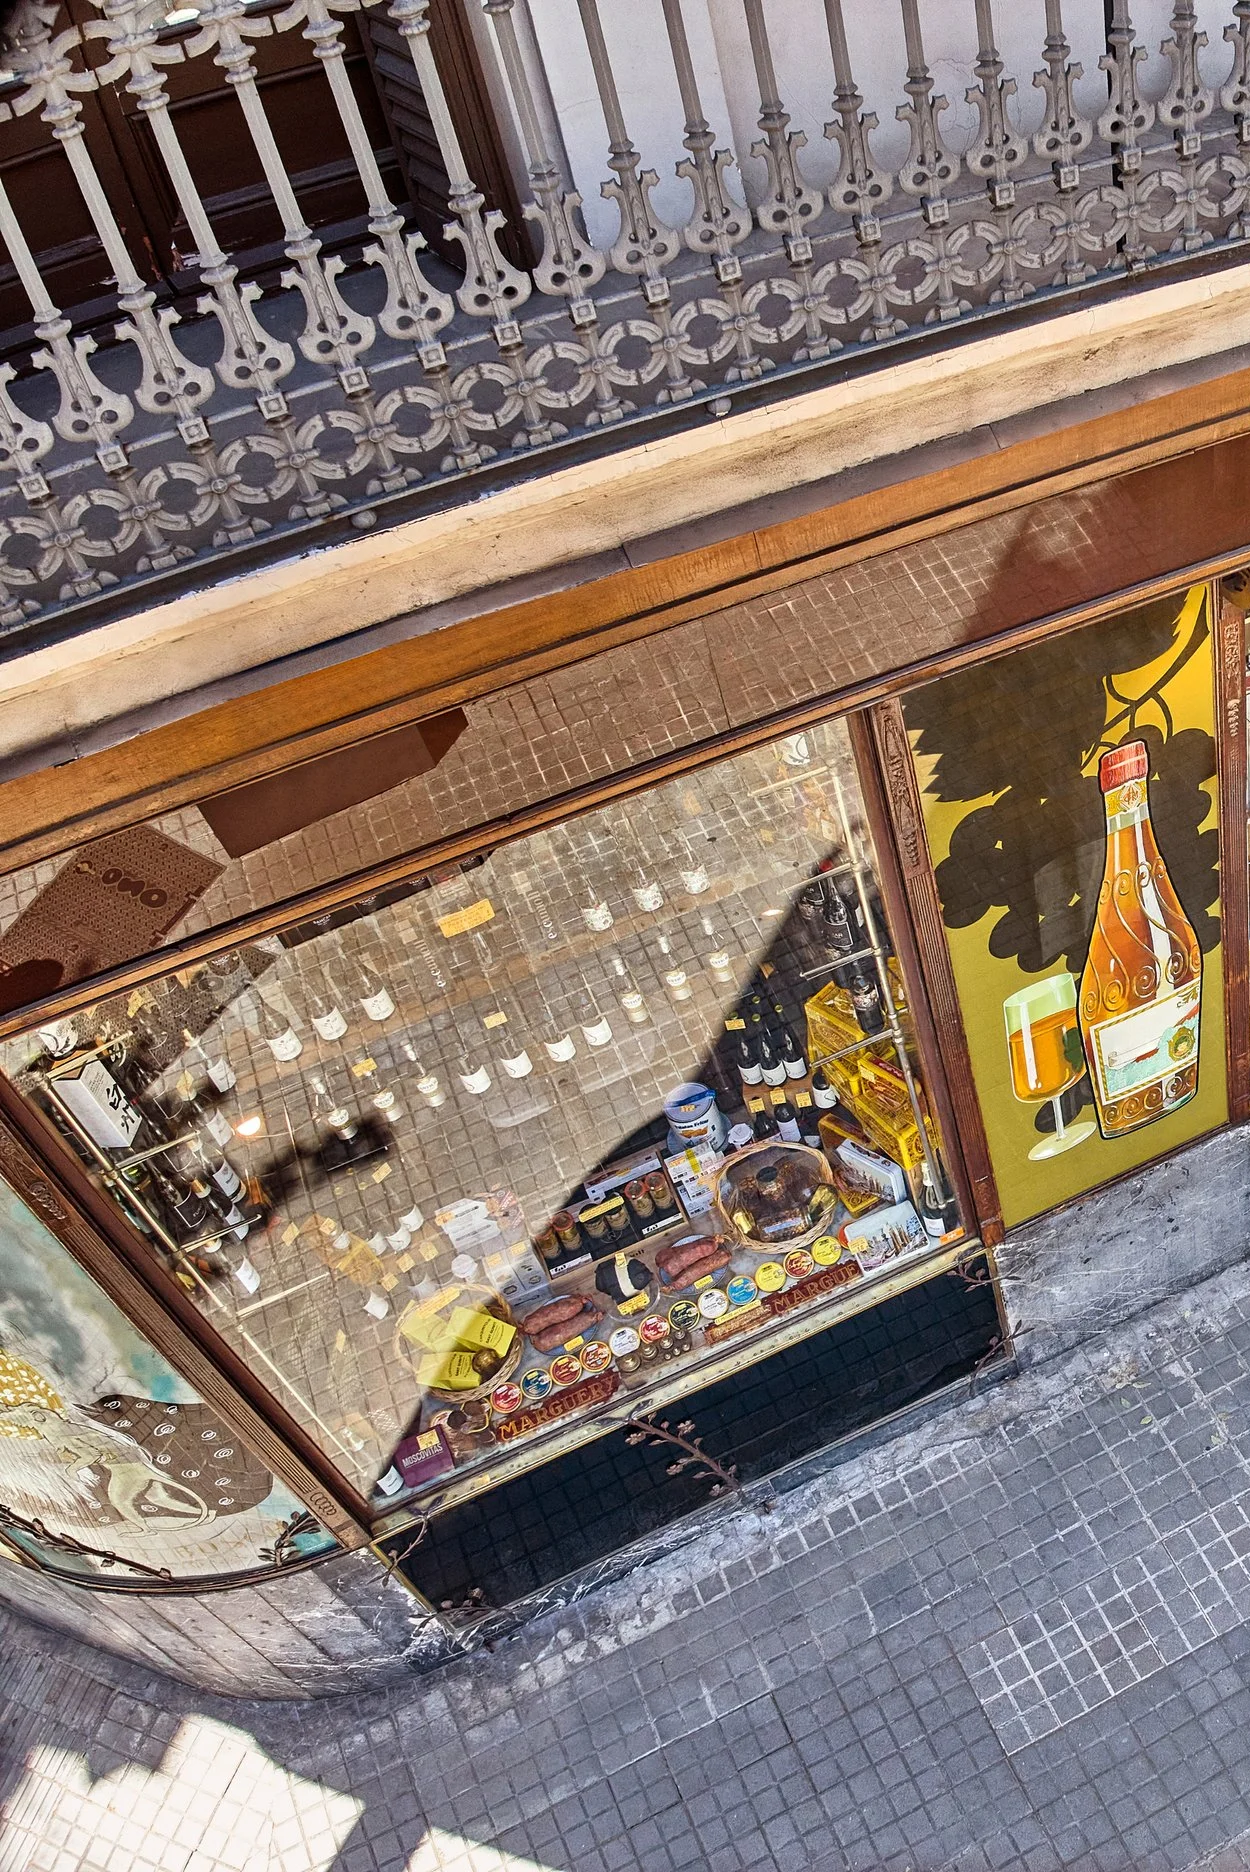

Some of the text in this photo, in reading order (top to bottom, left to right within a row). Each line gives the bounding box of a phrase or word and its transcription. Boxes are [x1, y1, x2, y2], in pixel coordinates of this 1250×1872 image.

[773, 1262, 860, 1315] MARGUE
[499, 1375, 616, 1441] MARGUERY
[402, 1443, 443, 1468] MOSCOVITAS
